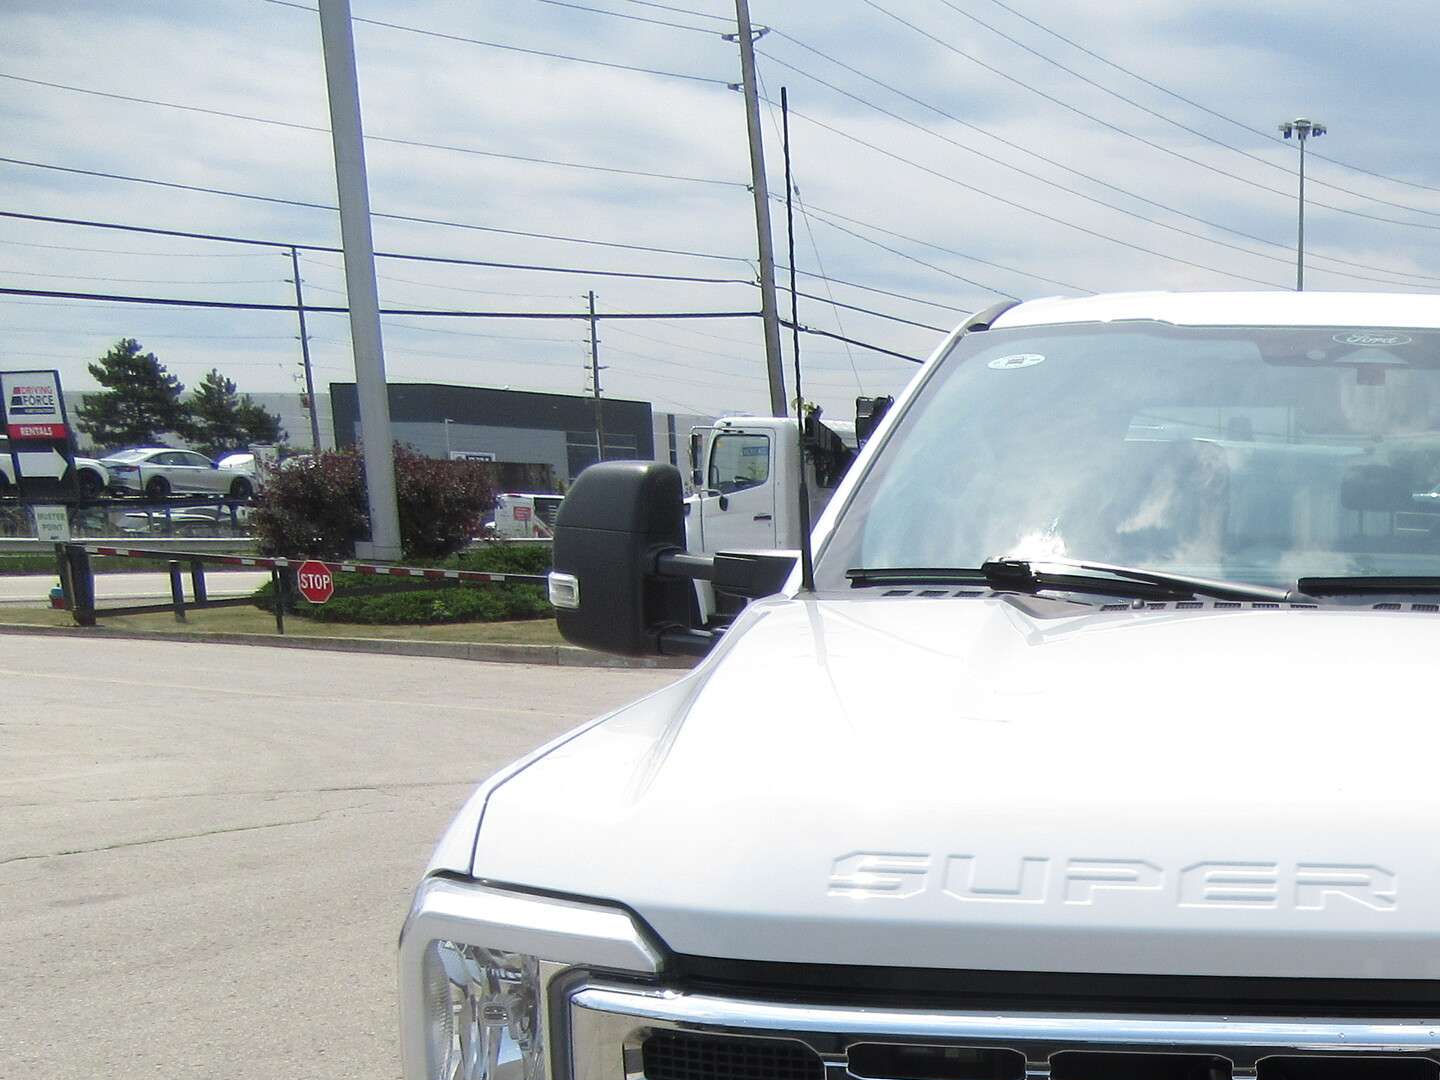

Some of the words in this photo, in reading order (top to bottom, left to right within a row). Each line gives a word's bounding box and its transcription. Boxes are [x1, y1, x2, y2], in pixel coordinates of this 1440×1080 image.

[1346, 334, 1399, 344] Ford
[20, 386, 53, 395] DRIVING
[22, 395, 54, 406] FORCE
[20, 426, 53, 437] RENTALS
[300, 573, 330, 590] STOP
[826, 850, 1398, 912] SUPER
